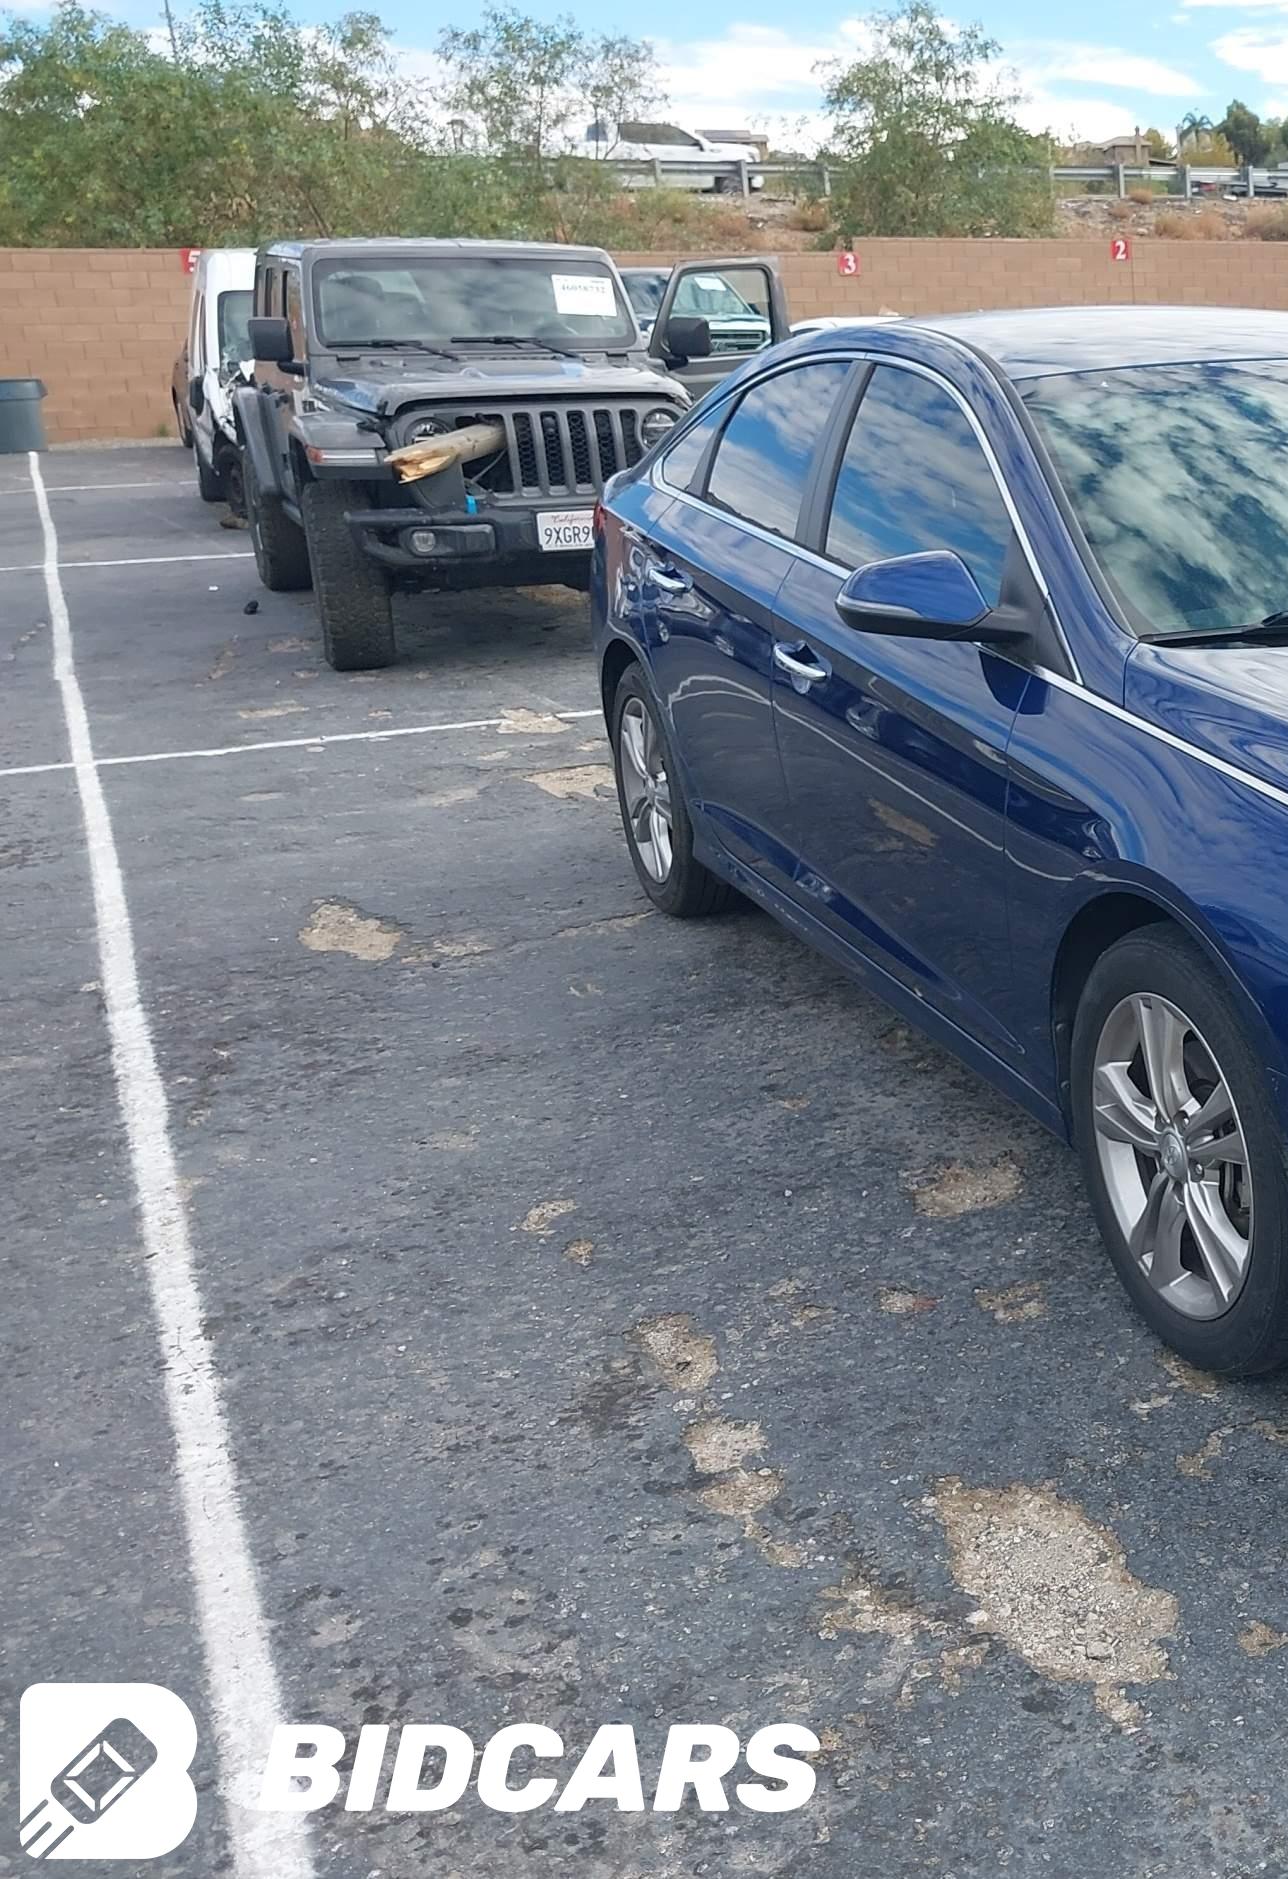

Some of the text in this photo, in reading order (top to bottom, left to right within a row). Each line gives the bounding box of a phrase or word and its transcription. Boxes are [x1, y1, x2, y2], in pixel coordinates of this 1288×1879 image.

[1115, 240, 1126, 260] 2
[844, 253, 856, 274] 3
[544, 525, 594, 545] 9XGR9
